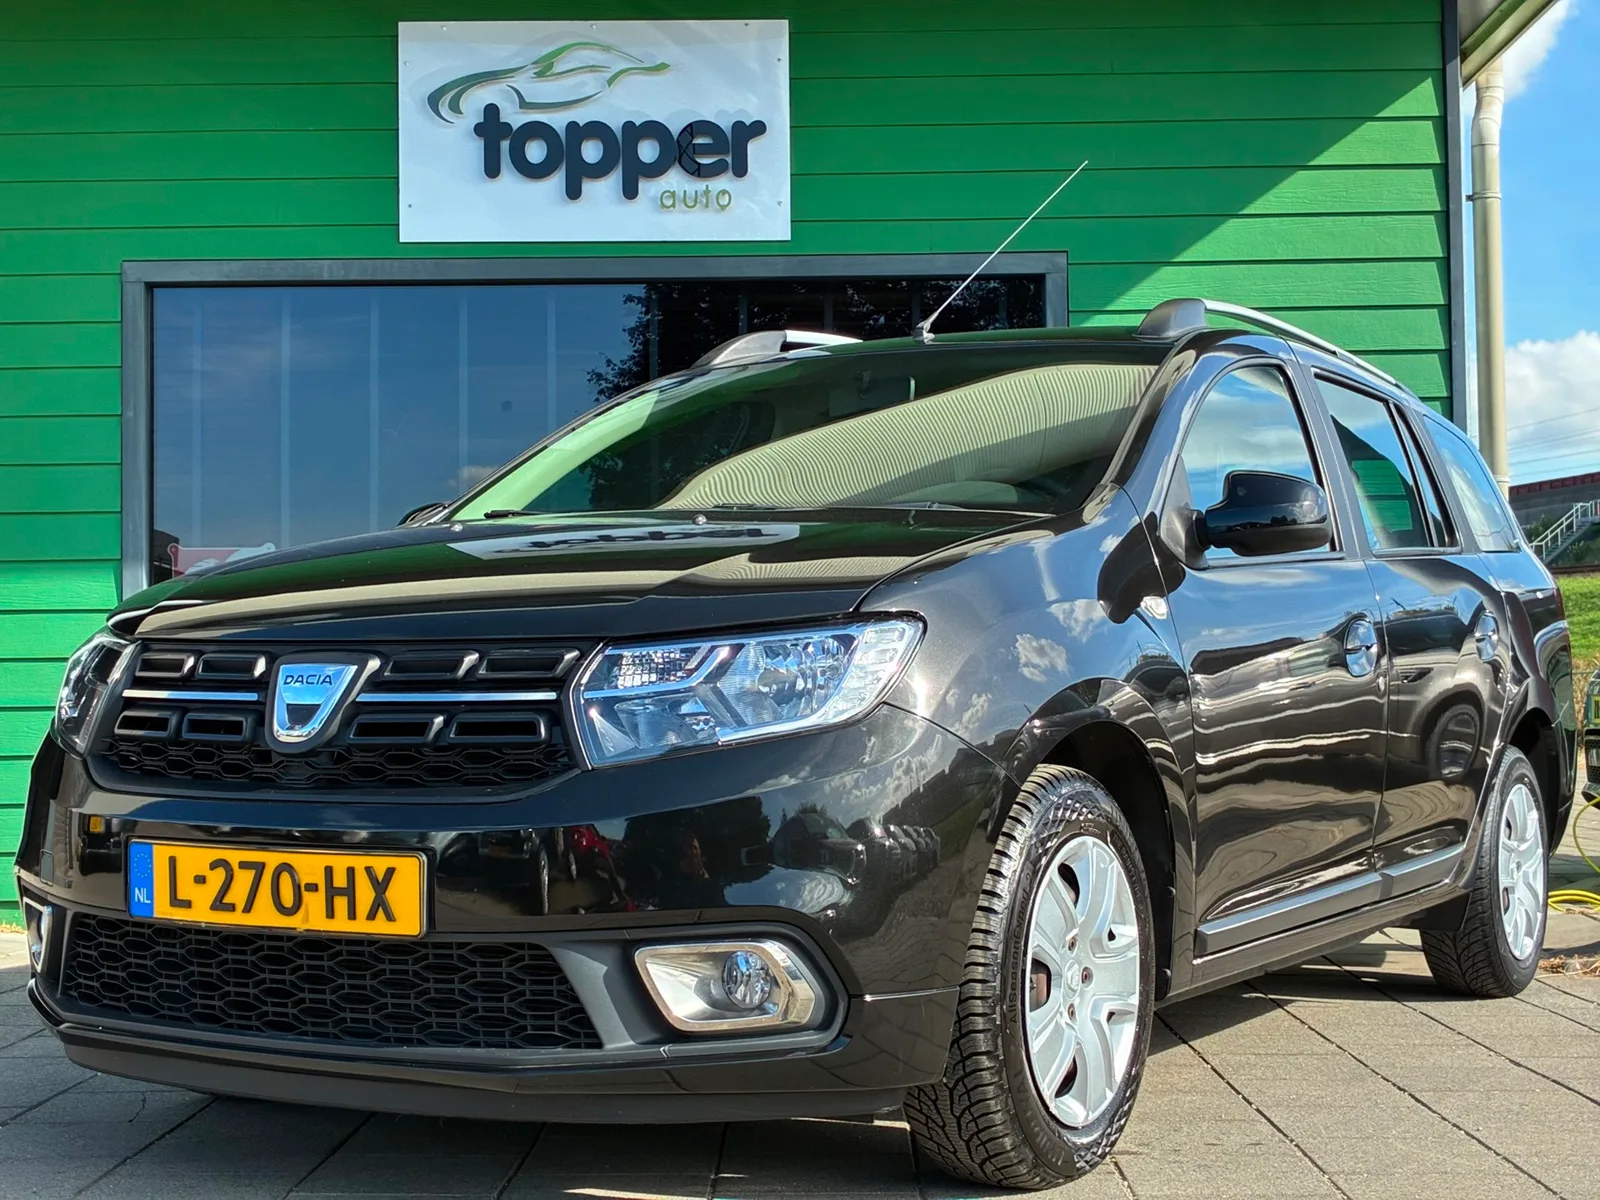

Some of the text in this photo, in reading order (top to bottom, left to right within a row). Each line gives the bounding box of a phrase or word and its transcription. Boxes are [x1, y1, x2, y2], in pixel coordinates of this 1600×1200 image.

[473, 102, 767, 200] topper
[659, 184, 733, 210] auto
[283, 674, 333, 686] DACIA
[135, 855, 397, 923] NL L-270-HX
